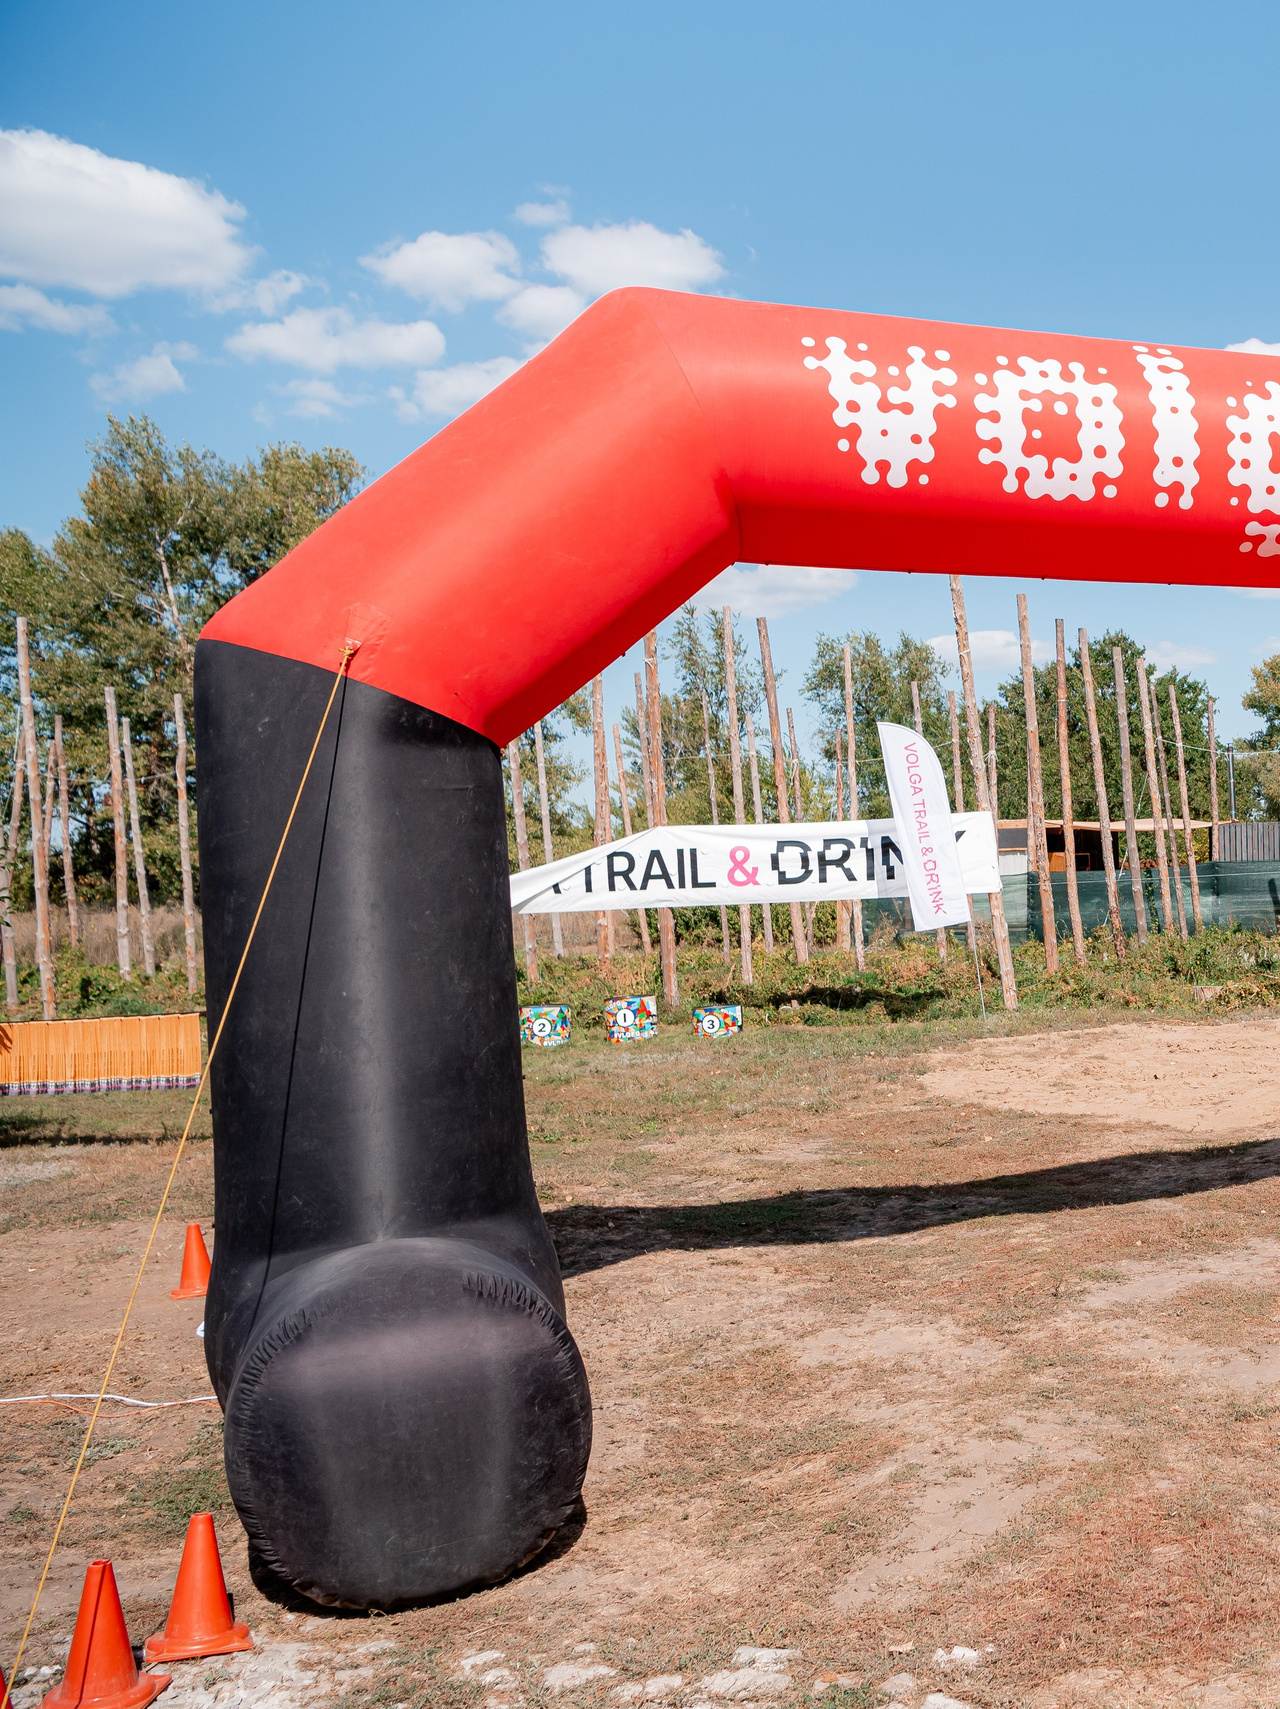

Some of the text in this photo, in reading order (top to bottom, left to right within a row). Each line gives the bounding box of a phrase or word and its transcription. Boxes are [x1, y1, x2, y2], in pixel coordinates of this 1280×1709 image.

[904, 742, 947, 915] VOLGA TRAIL & DRINK
[727, 846, 760, 886] &
[537, 1022, 546, 1033] 2
[707, 1019, 715, 1030] 3
